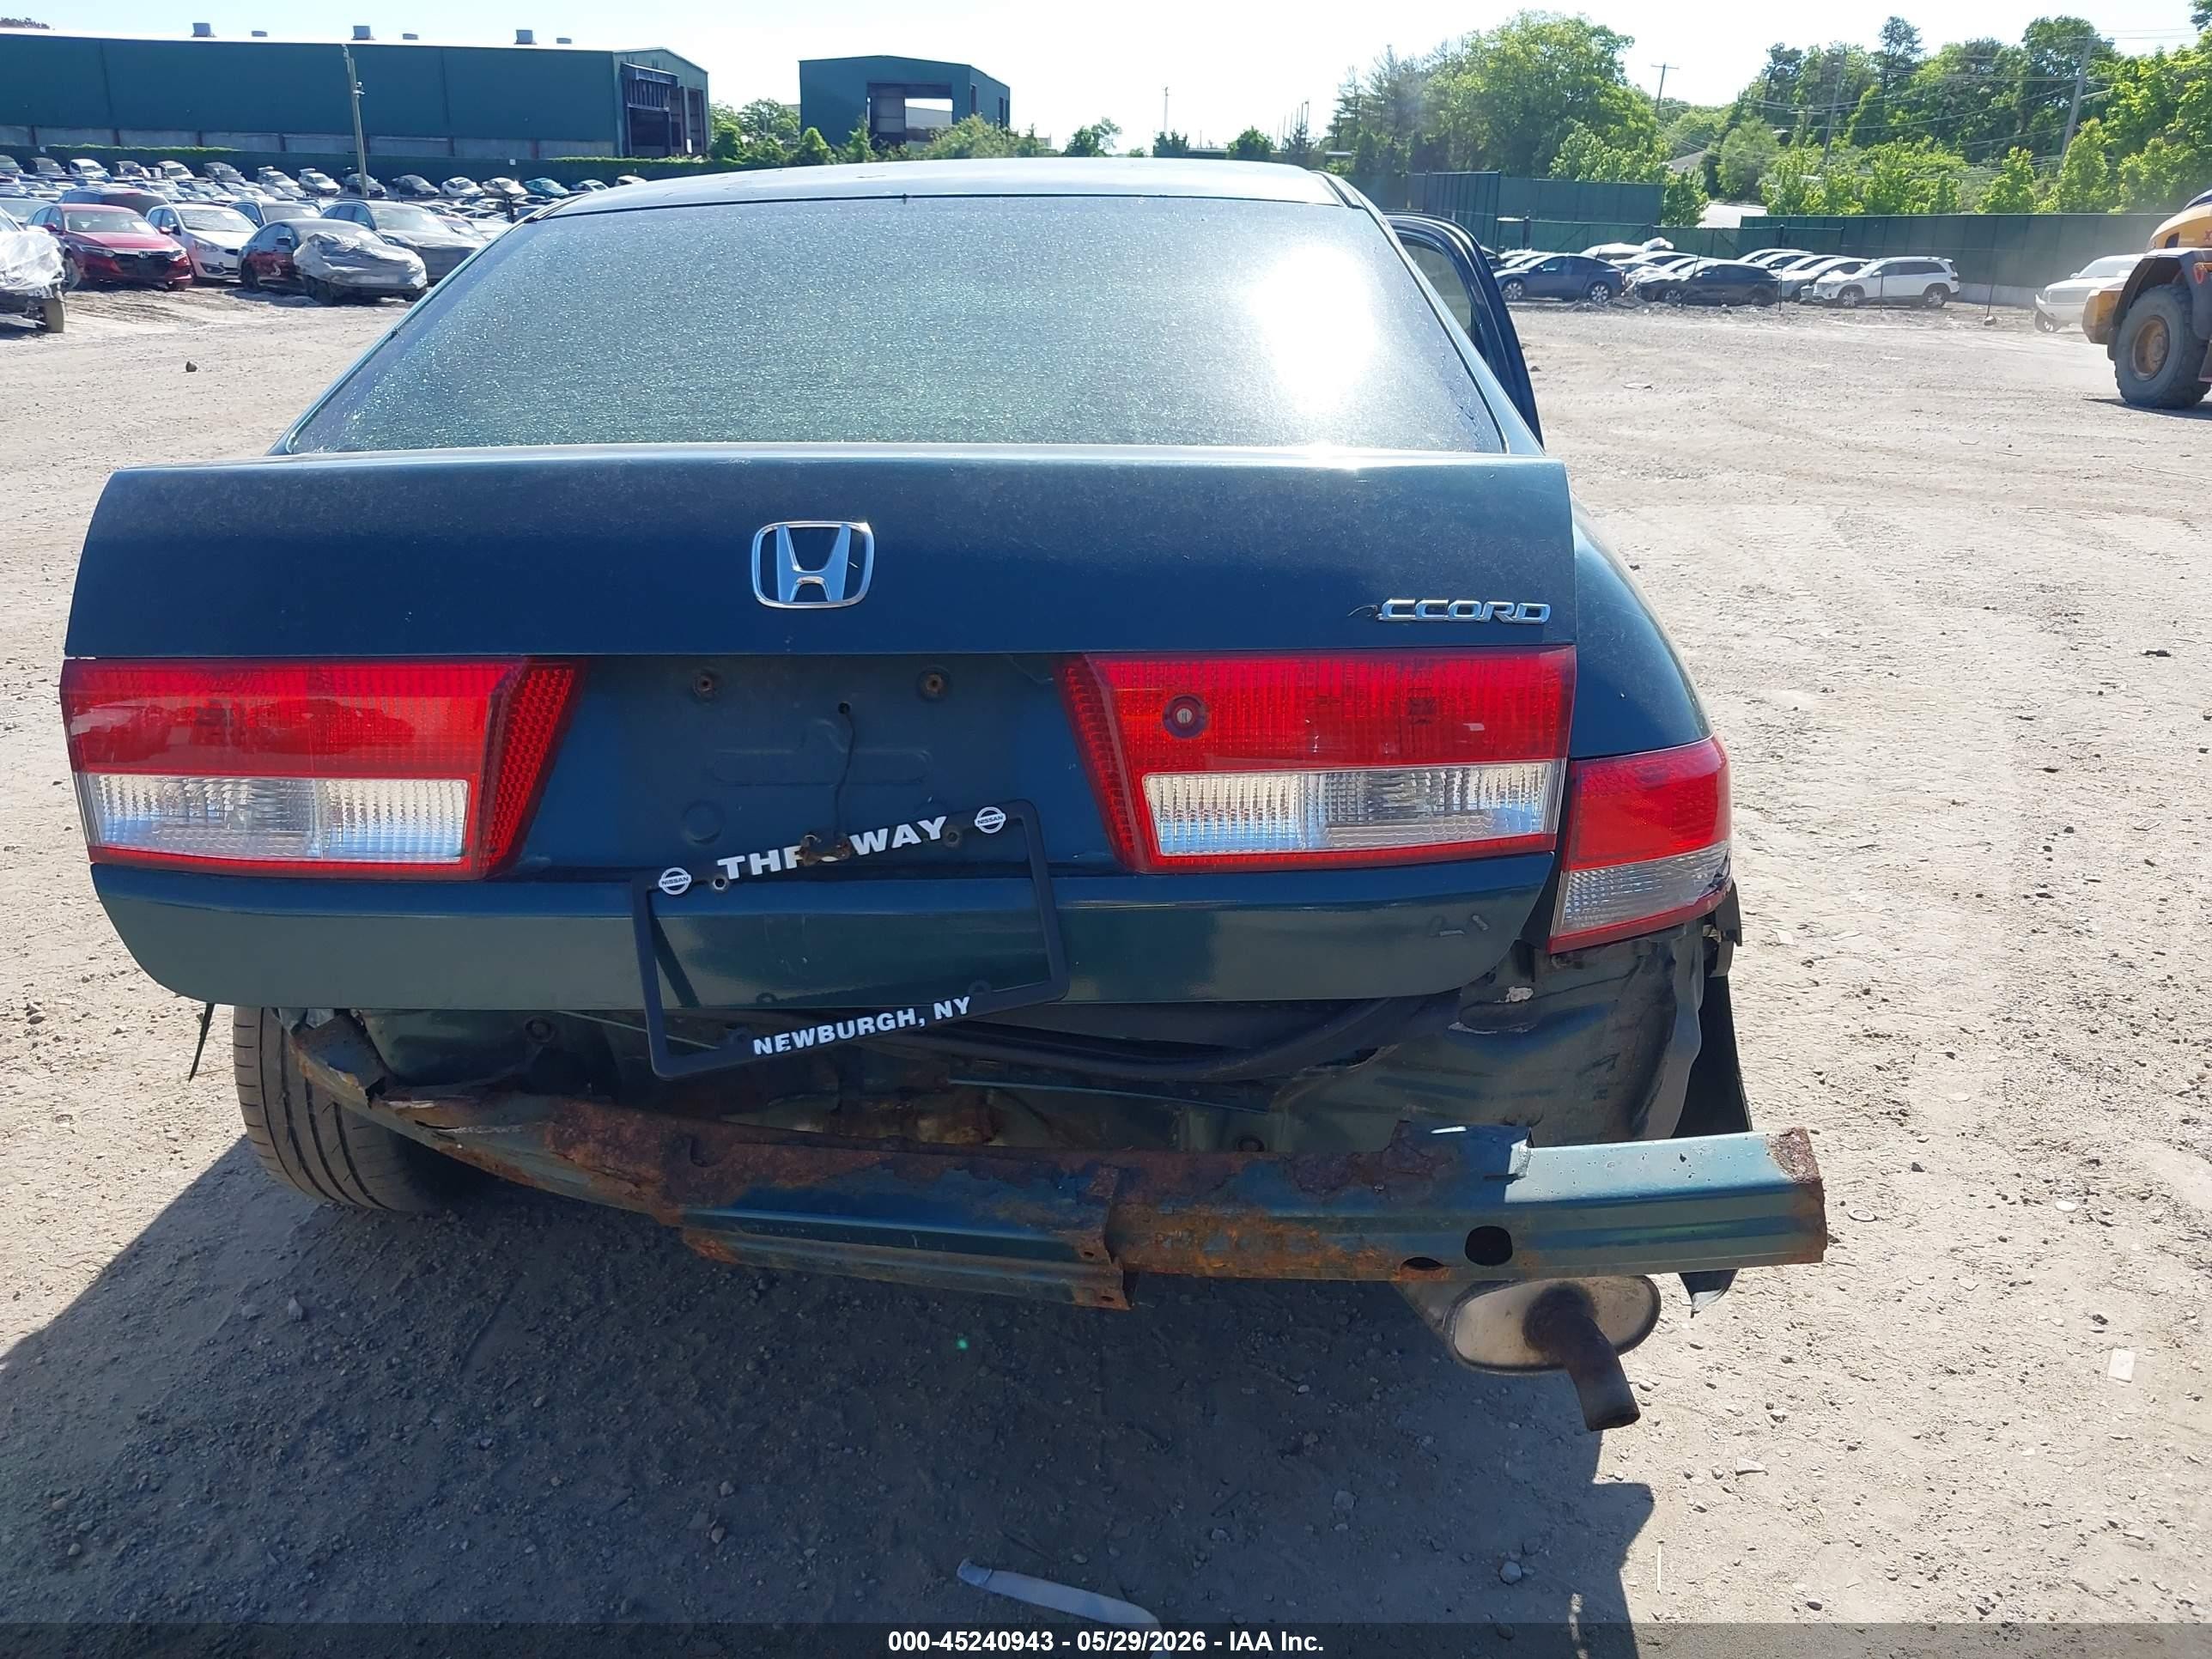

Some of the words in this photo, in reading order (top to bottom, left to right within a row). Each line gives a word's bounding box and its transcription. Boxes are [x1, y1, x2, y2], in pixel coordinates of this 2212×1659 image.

[716, 816, 947, 880] THRWAY
[752, 1007, 926, 1056] NEWBURGH,
[933, 995, 971, 1020] NY
